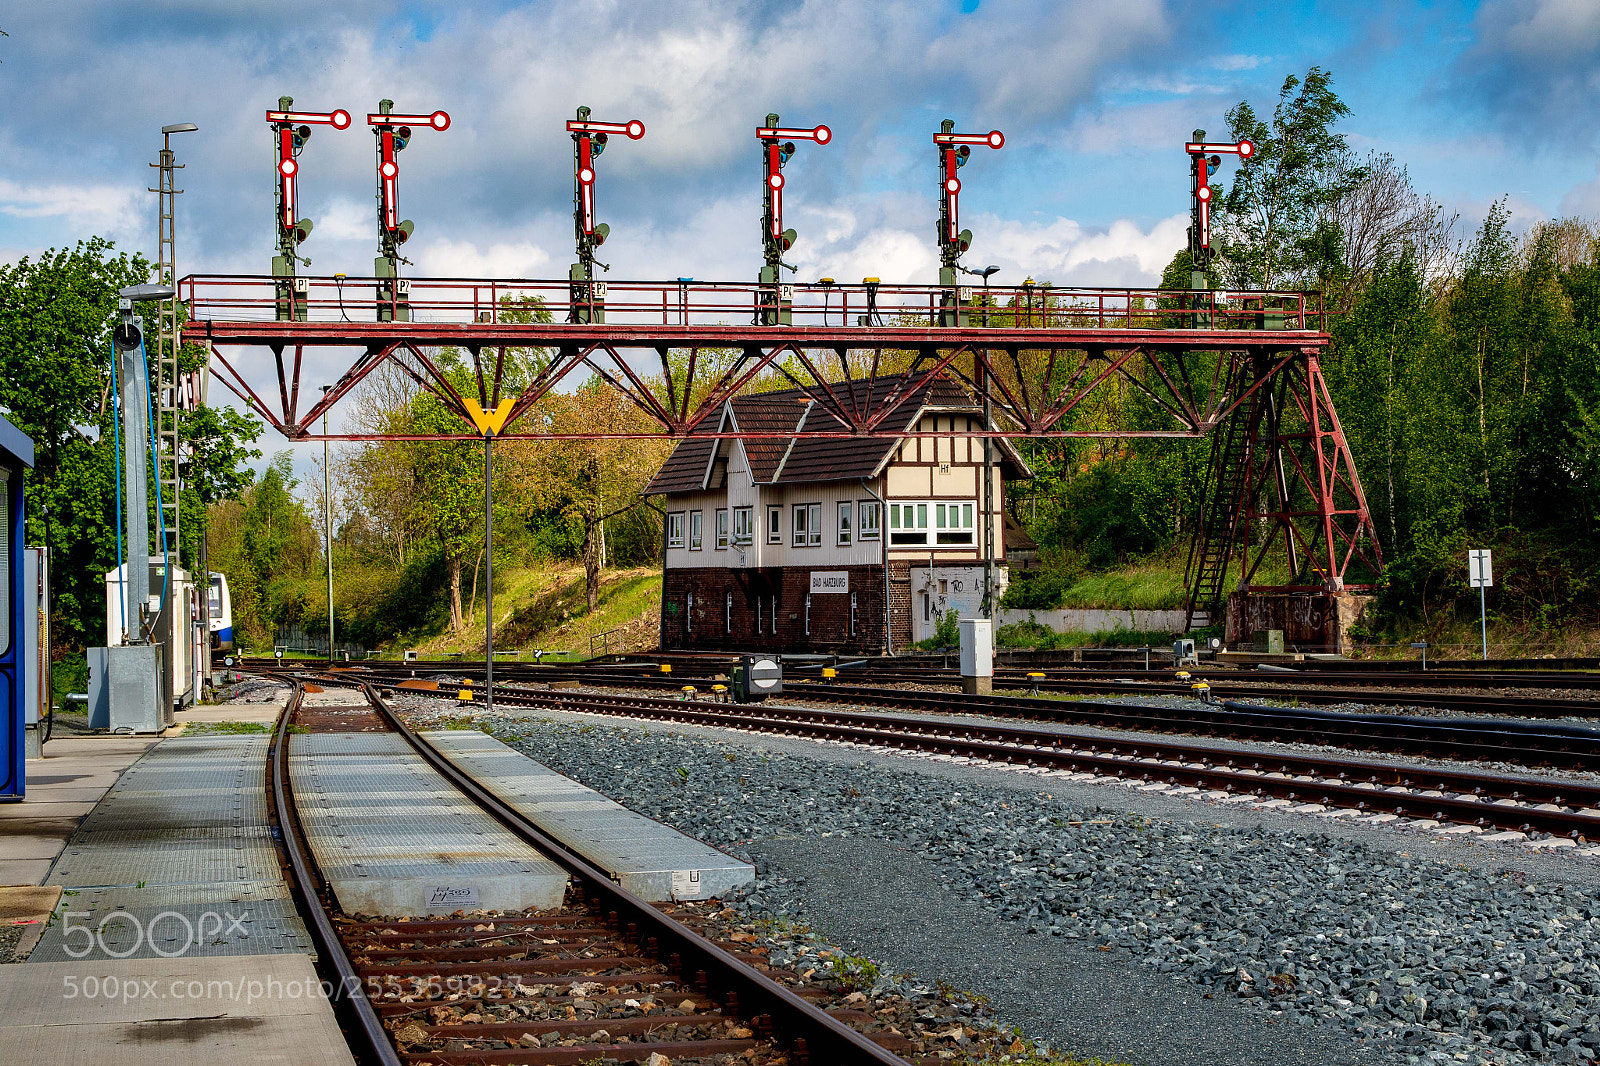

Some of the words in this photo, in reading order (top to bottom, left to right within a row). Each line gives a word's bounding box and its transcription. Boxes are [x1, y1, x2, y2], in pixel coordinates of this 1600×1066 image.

[298, 279, 307, 291] P1
[399, 280, 410, 292] P2
[596, 283, 606, 295] P3
[461, 398, 517, 437] W
[812, 577, 821, 588] BAD
[823, 577, 846, 588] HARZBURG
